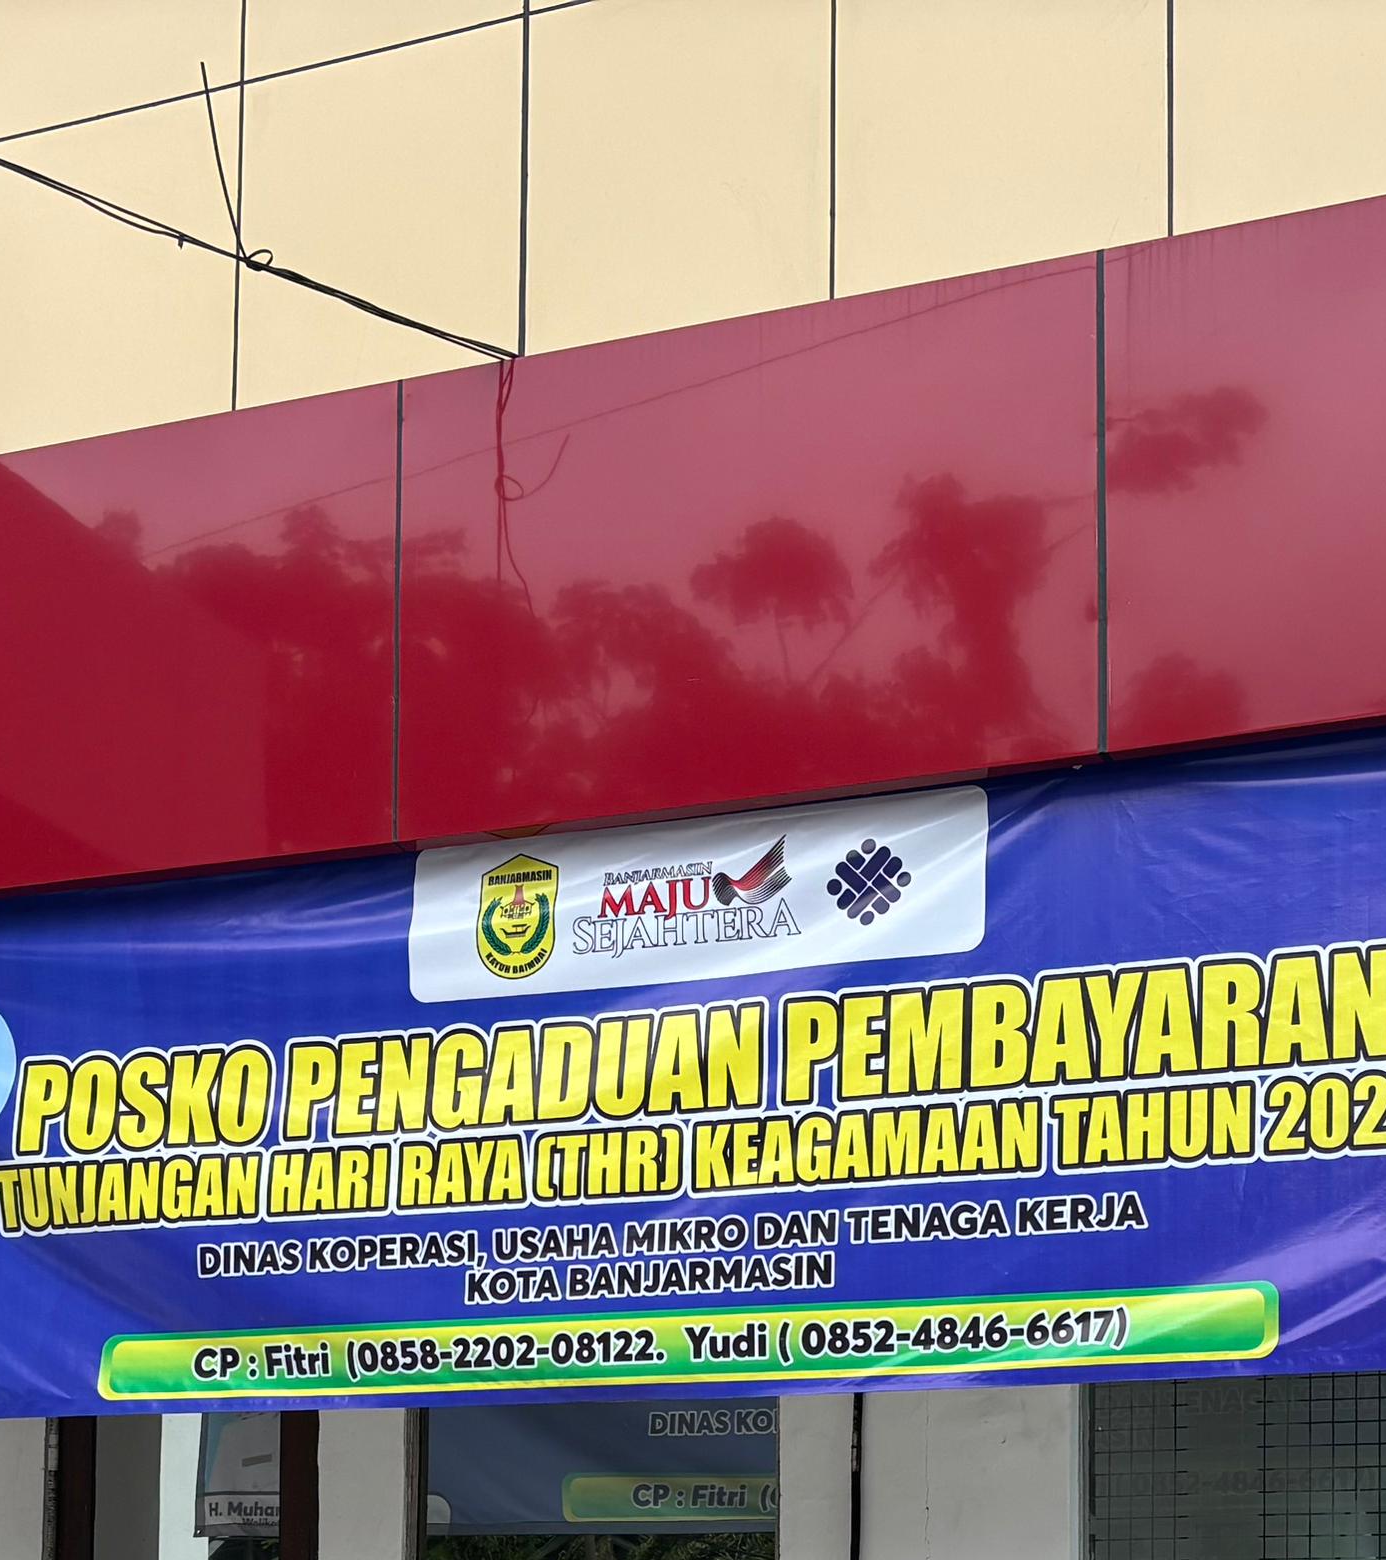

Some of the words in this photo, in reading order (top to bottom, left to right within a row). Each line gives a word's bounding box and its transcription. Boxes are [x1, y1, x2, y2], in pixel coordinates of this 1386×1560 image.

[598, 876, 711, 920] MAJU
[603, 861, 713, 886] BANJARMASIN
[572, 898, 801, 958] SEJAHTERA
[15, 1042, 275, 1156] POSKO
[286, 1000, 767, 1140] PENGADUAN
[267, 1141, 392, 1216] HARI
[396, 1132, 536, 1209] RAYA
[532, 1122, 679, 1202] (THR)
[694, 1095, 1040, 1189] KEAGAMAAN
[1053, 1081, 1254, 1167] TAHUN
[199, 1242, 301, 1276] DINAS
[309, 1233, 486, 1272] KOPERASI,
[493, 1224, 615, 1261] USAHA
[624, 1216, 747, 1255] MIKRO
[757, 1211, 837, 1247] DAN
[846, 1201, 1010, 1243] TENAGA
[1018, 1193, 1148, 1235] KERJA
[465, 1267, 559, 1305] KOTA
[566, 1252, 835, 1299] BANJARMASIN
[194, 1347, 240, 1379] CP
[265, 1342, 332, 1378] Fitri
[686, 1322, 767, 1363] Yudi
[648, 1410, 731, 1436] DINAS
[632, 1483, 671, 1509] CP
[690, 1483, 748, 1508] Fitri
